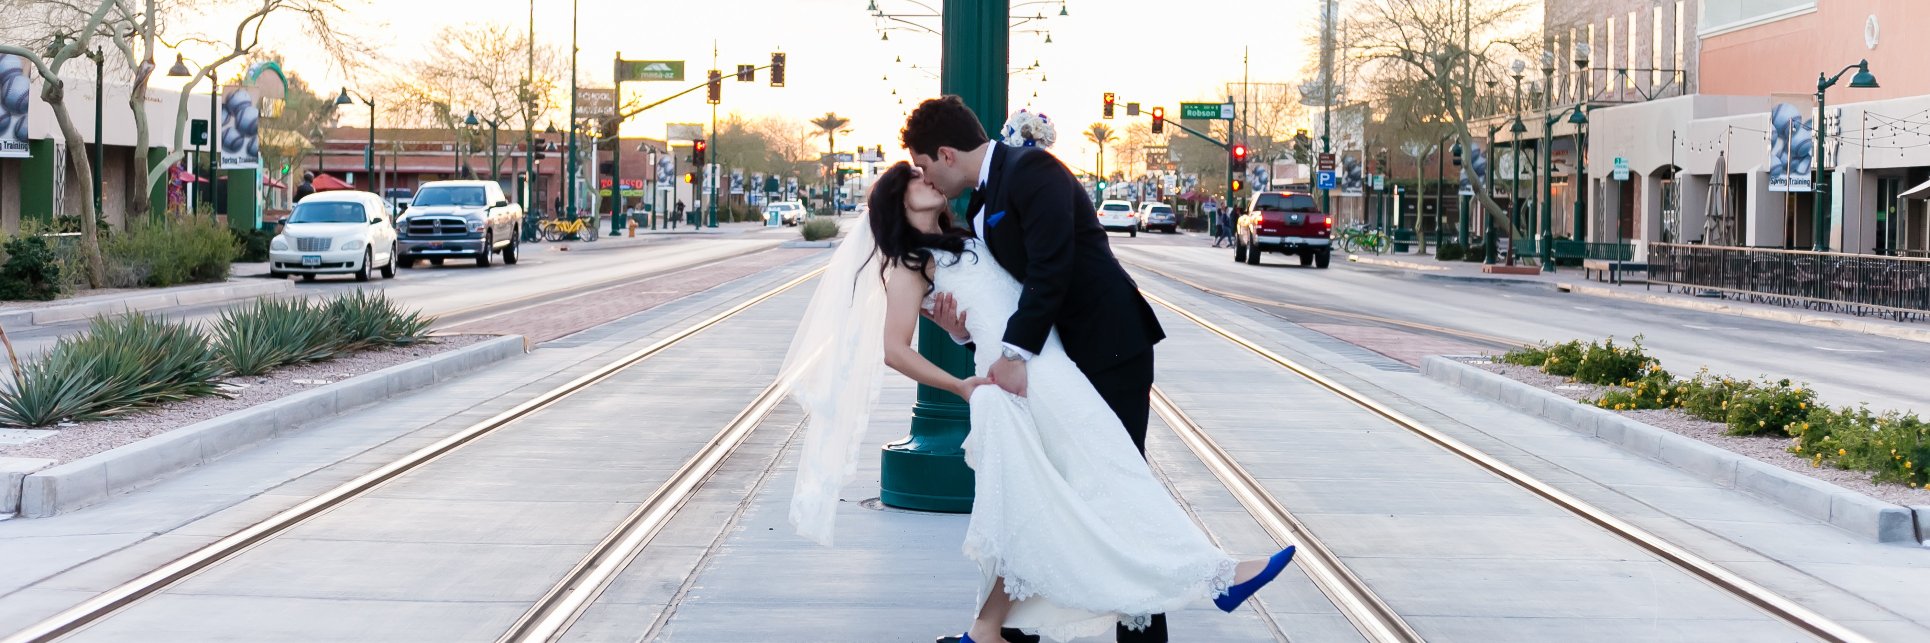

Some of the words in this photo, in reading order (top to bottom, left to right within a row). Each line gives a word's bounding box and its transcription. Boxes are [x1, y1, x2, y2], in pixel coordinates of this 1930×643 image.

[1186, 109, 1216, 117] Robson
[3, 140, 29, 152] Training
[1320, 172, 1330, 185] P
[1770, 178, 1787, 186] Spring
[1789, 178, 1810, 187] Training
